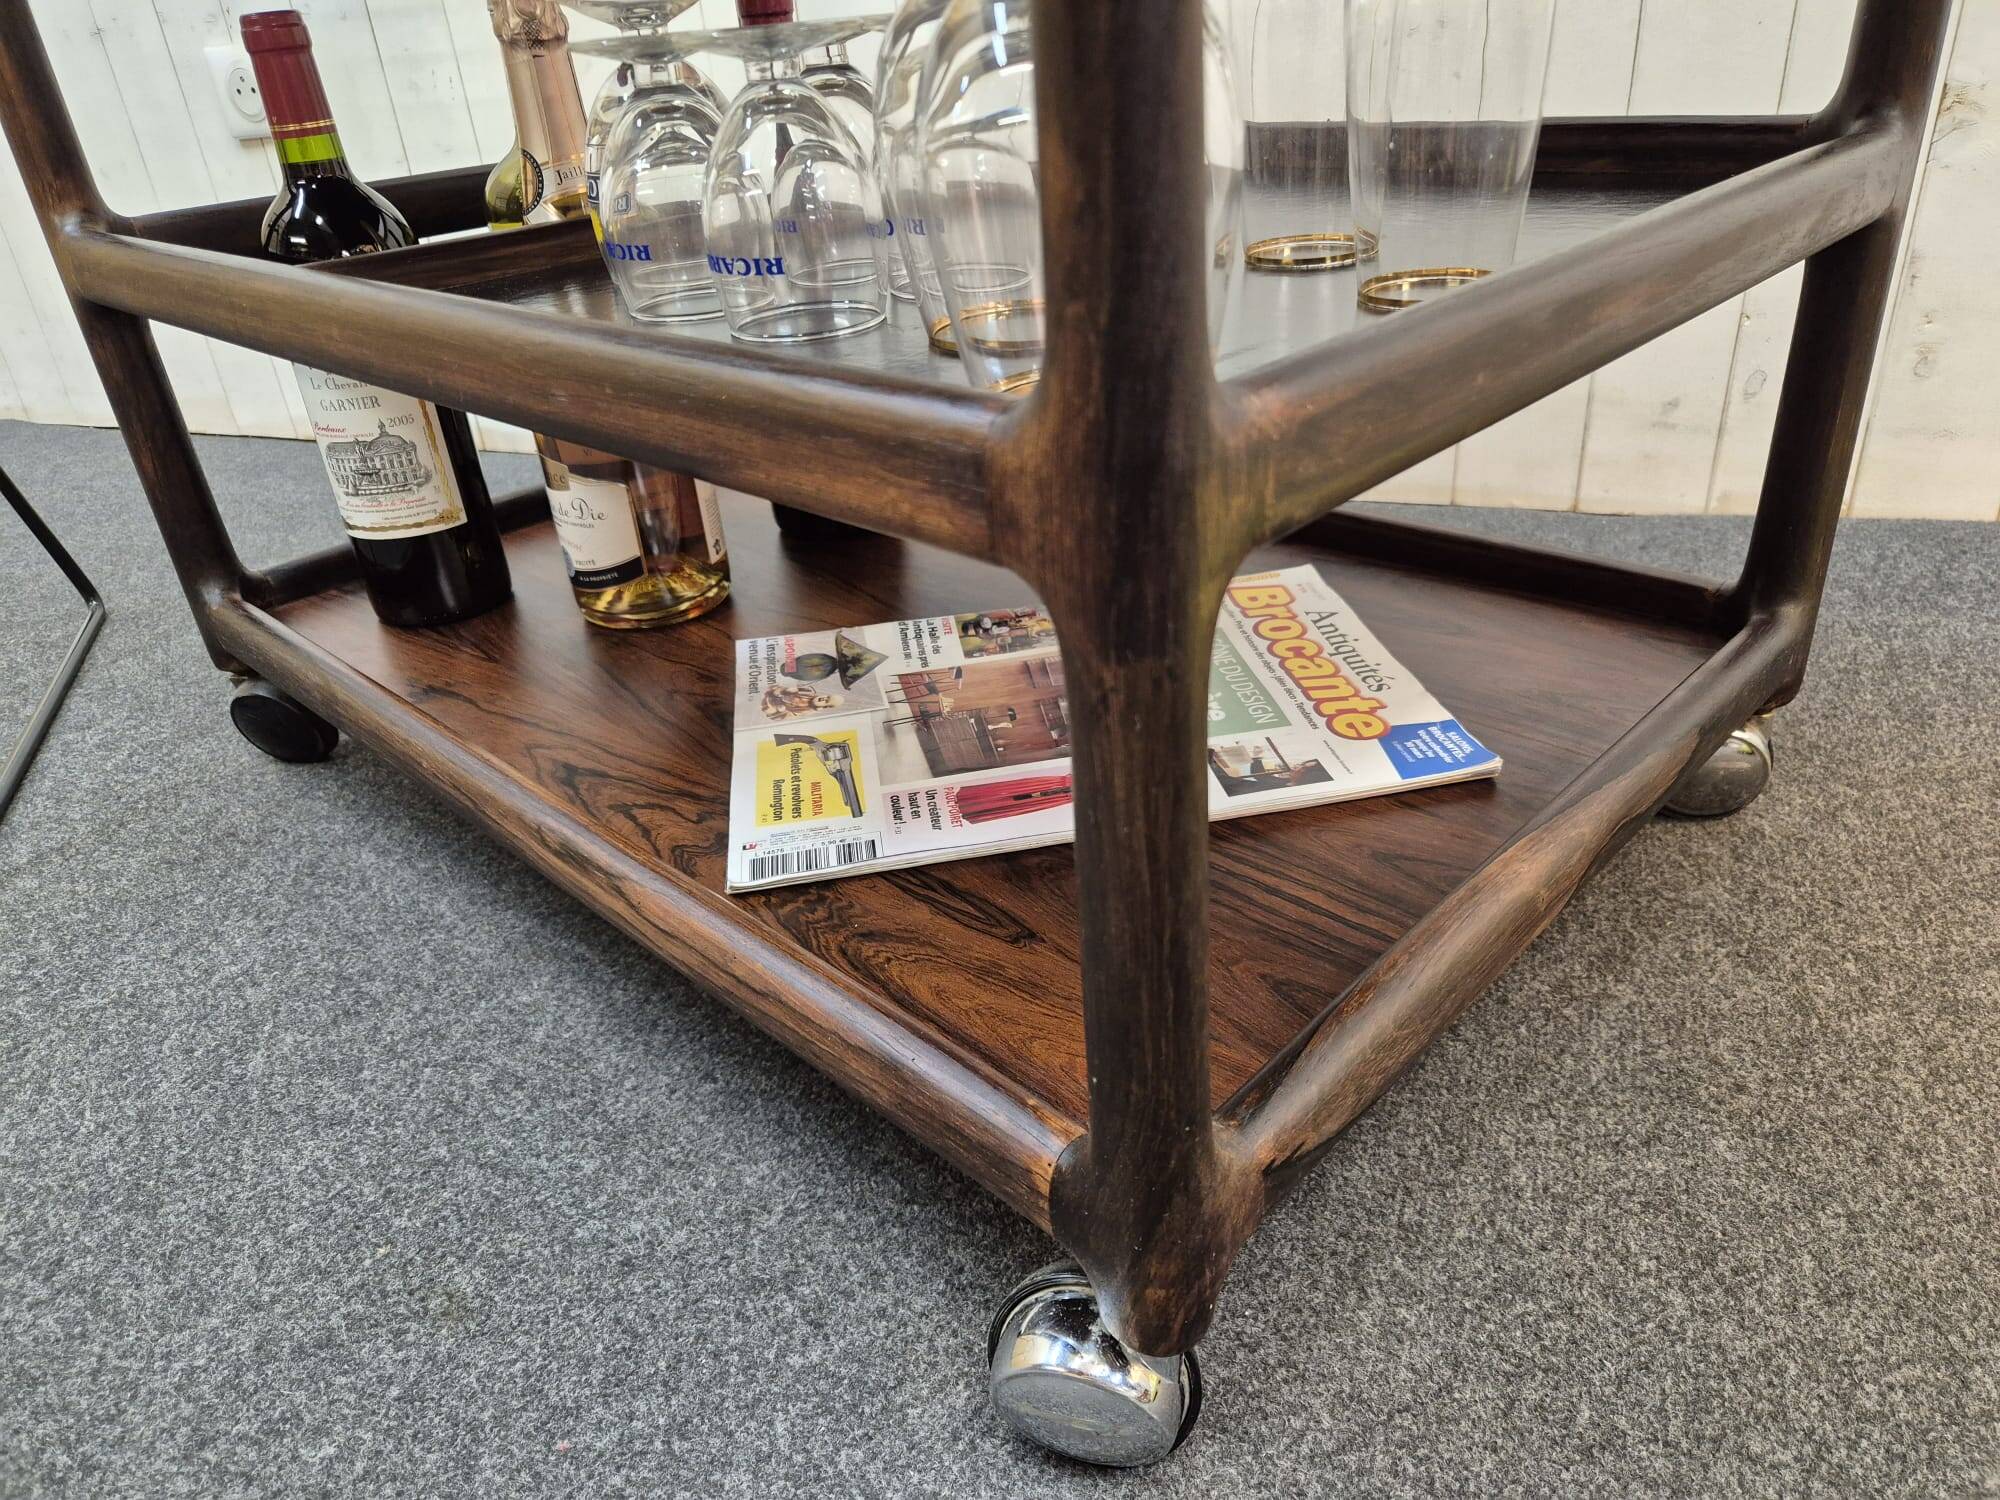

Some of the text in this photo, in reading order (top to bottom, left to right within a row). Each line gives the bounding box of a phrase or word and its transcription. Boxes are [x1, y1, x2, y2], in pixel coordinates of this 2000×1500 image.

[319, 395, 382, 413] GARNIER
[387, 413, 415, 428] 2005
[558, 497, 609, 521] de Die
[748, 640, 758, 665] venue
[1226, 585, 1391, 740] Brocante
[1304, 611, 1395, 693] Antiquités
[1218, 664, 1249, 683] DU
[1229, 682, 1280, 724] DESIGN
[769, 779, 786, 821] Remington
[790, 747, 805, 819] Pistolets et revolvers
[810, 781, 823, 817] MILITARIA
[908, 791, 921, 820] haut en
[925, 789, 943, 831] Un créateur
[944, 786, 963, 828] PAUL POIRET
